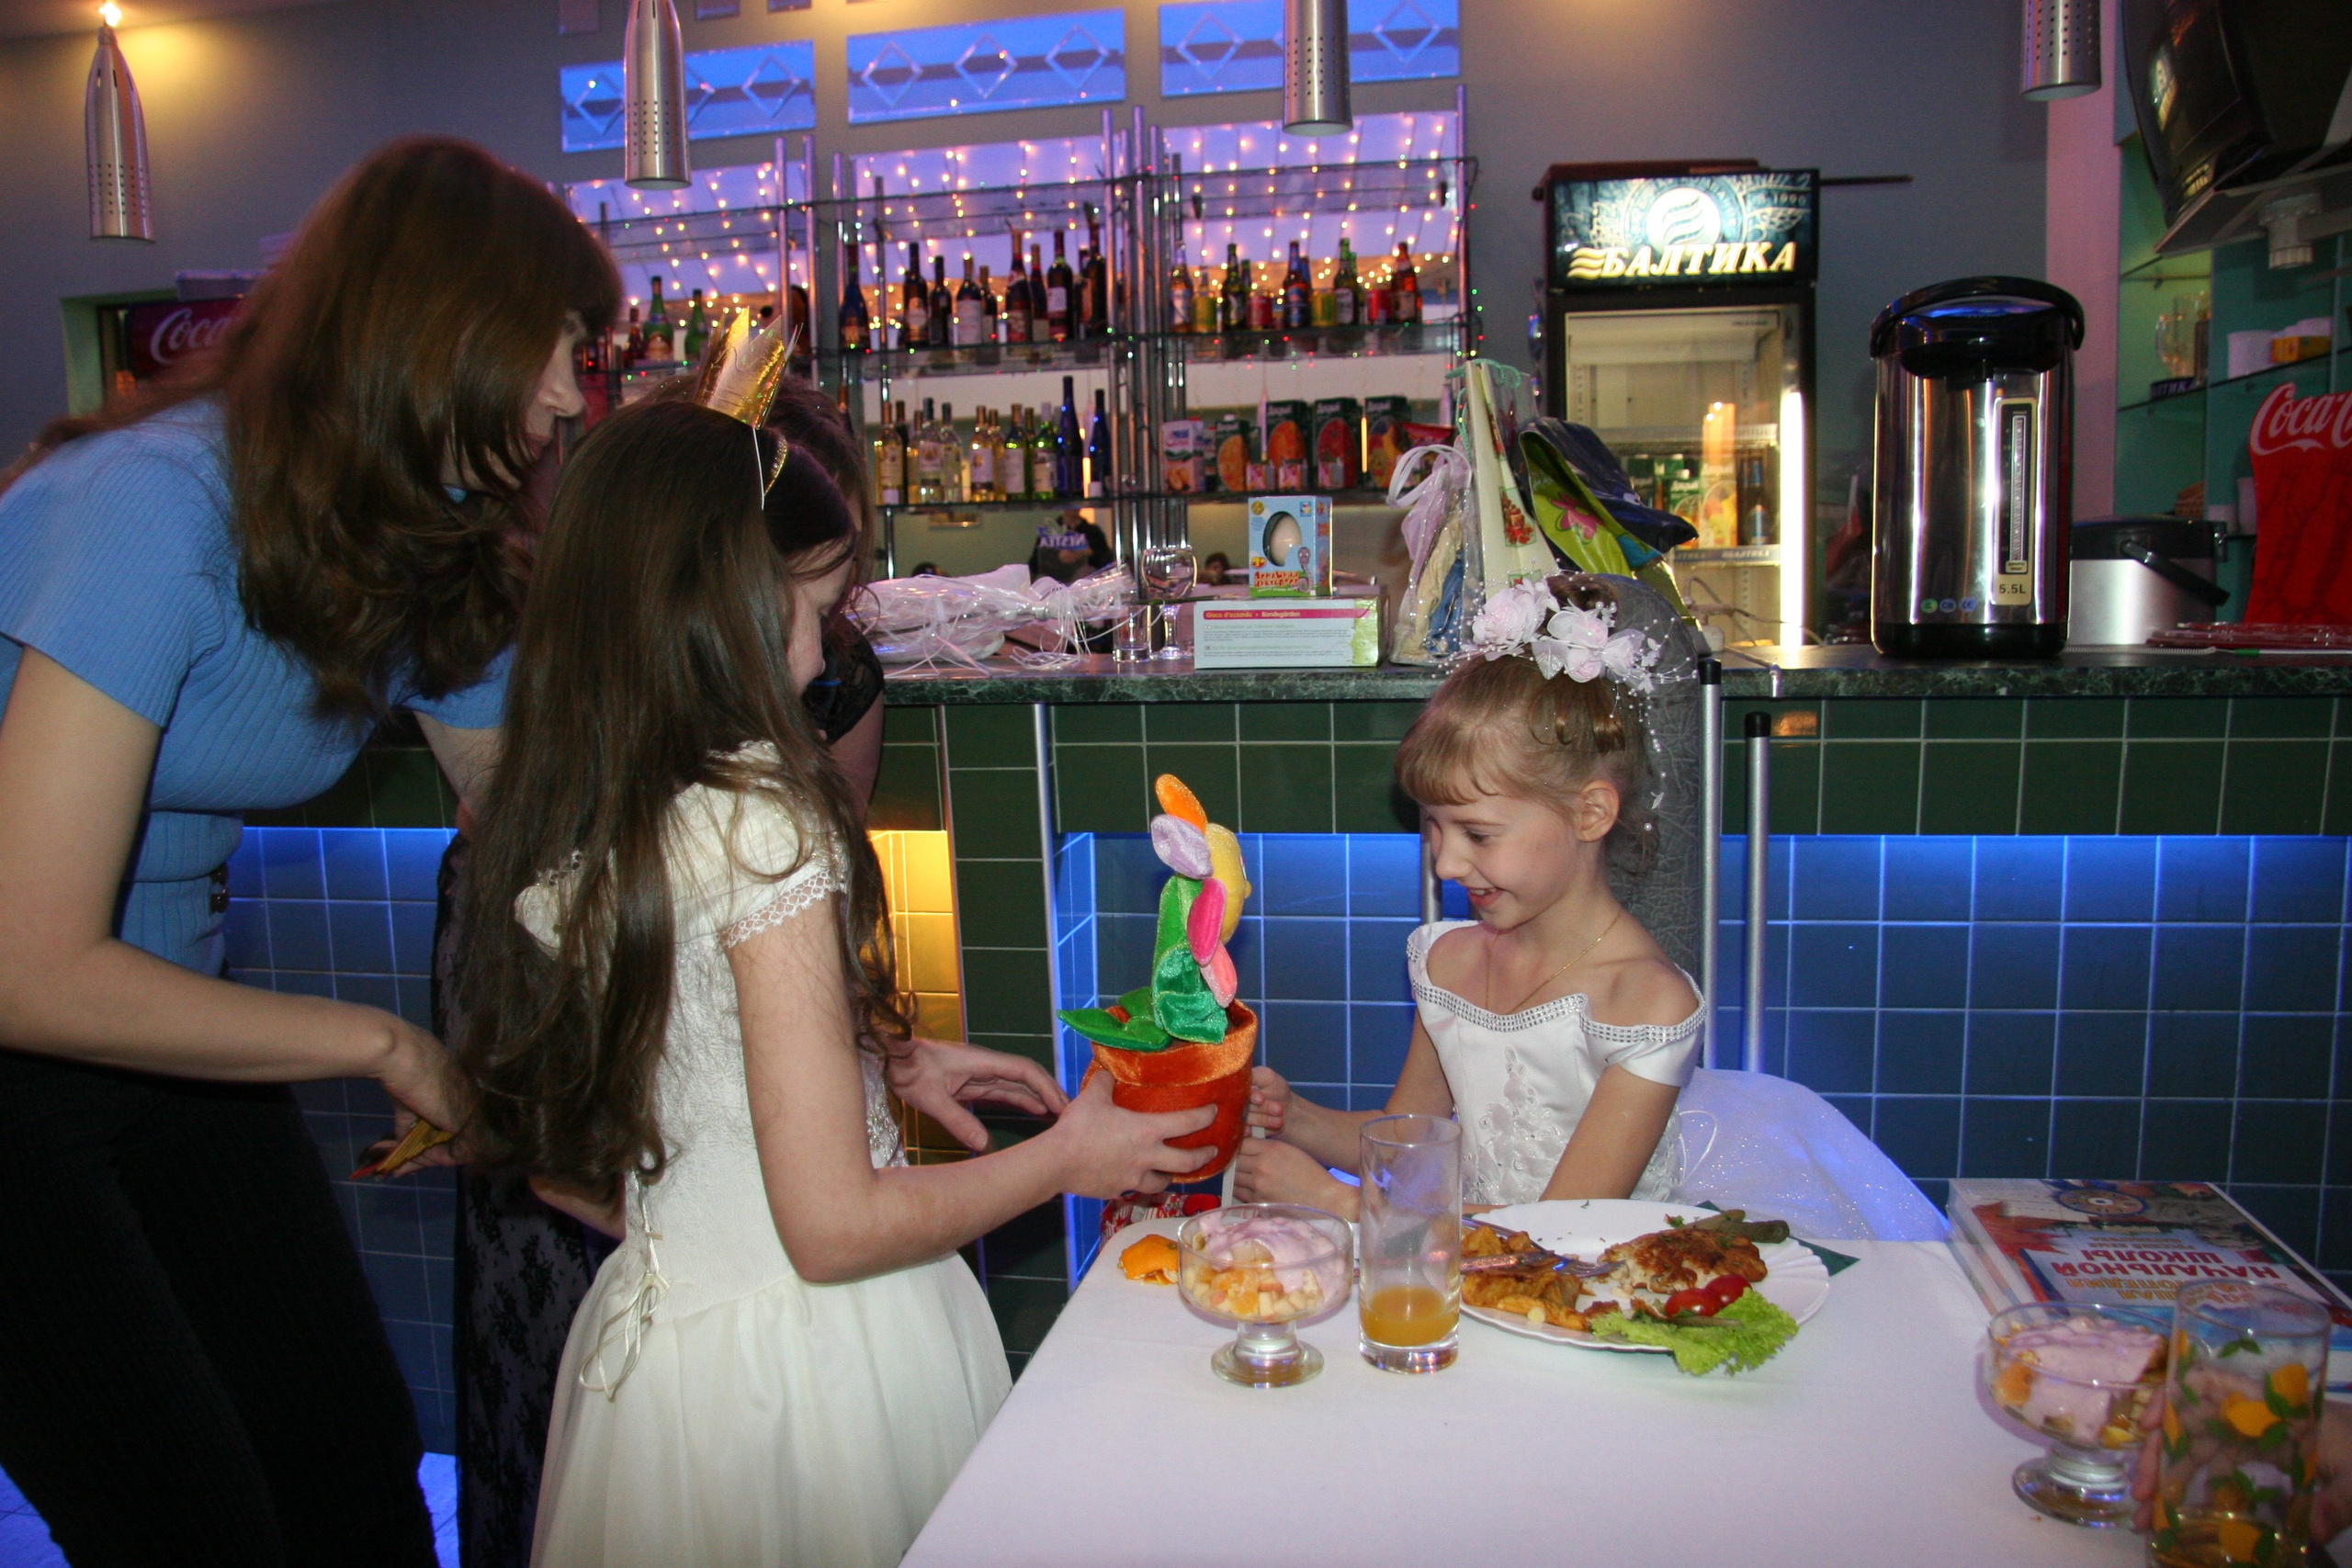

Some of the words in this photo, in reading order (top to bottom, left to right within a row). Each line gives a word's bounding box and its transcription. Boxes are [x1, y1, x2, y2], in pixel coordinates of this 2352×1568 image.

[1600, 242, 1797, 278] БАЛТИКА
[1999, 583, 2026, 594] 5.5L
[2081, 1249, 2223, 1263] ШКОЛЫ
[2051, 1261, 2281, 1279] НАЧАЛЬНОЙ
